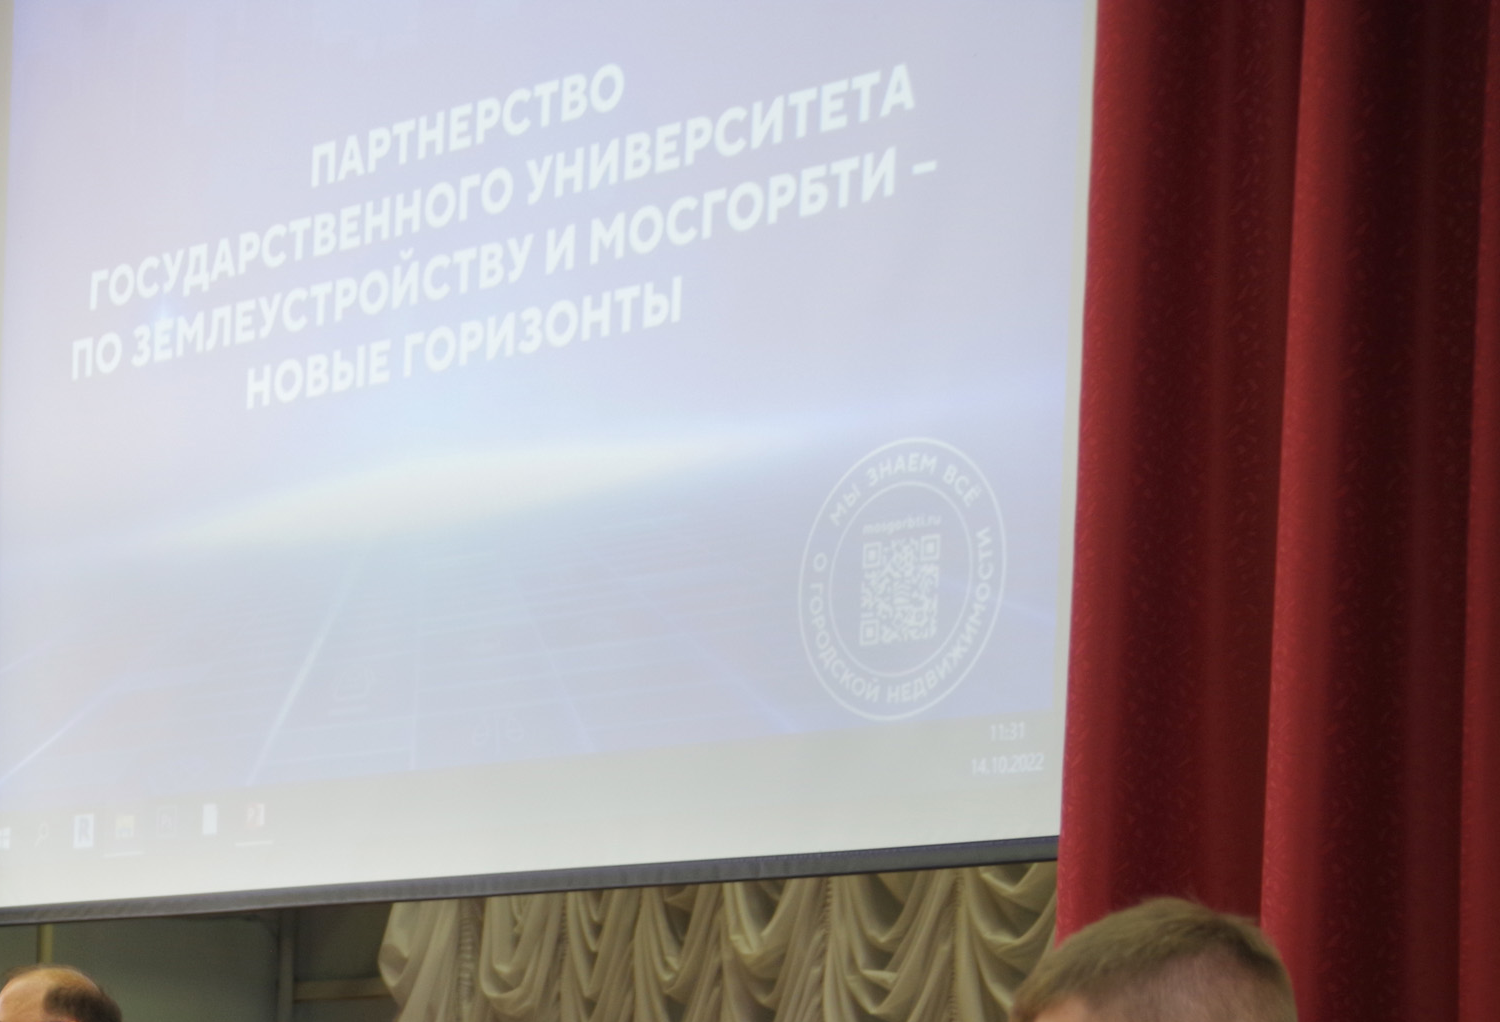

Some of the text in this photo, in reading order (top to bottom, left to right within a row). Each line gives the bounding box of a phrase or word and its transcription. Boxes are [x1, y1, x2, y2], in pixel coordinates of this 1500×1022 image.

[88, 62, 916, 311] ГОСУДАРСТВЕННОГО УНИВЕРСИТЕТА
[309, 63, 626, 188] ПАРТНЕРСТВО
[71, 331, 123, 381] ПО
[131, 235, 534, 368] ЗЕМЛЕУСТРОЙСТВУ
[544, 224, 578, 275] И
[588, 146, 897, 264] МОСГОРБТИ
[245, 275, 684, 409] НОВЫЕ ГОРИЗОНТЫ
[829, 484, 862, 526] МЫ
[865, 452, 938, 487] ЗНАЕМ
[809, 525, 994, 704] О ГОРОДСКОЙ НЕДВИЖИМОСТИ
[971, 752, 1045, 776] 14.10.2022
